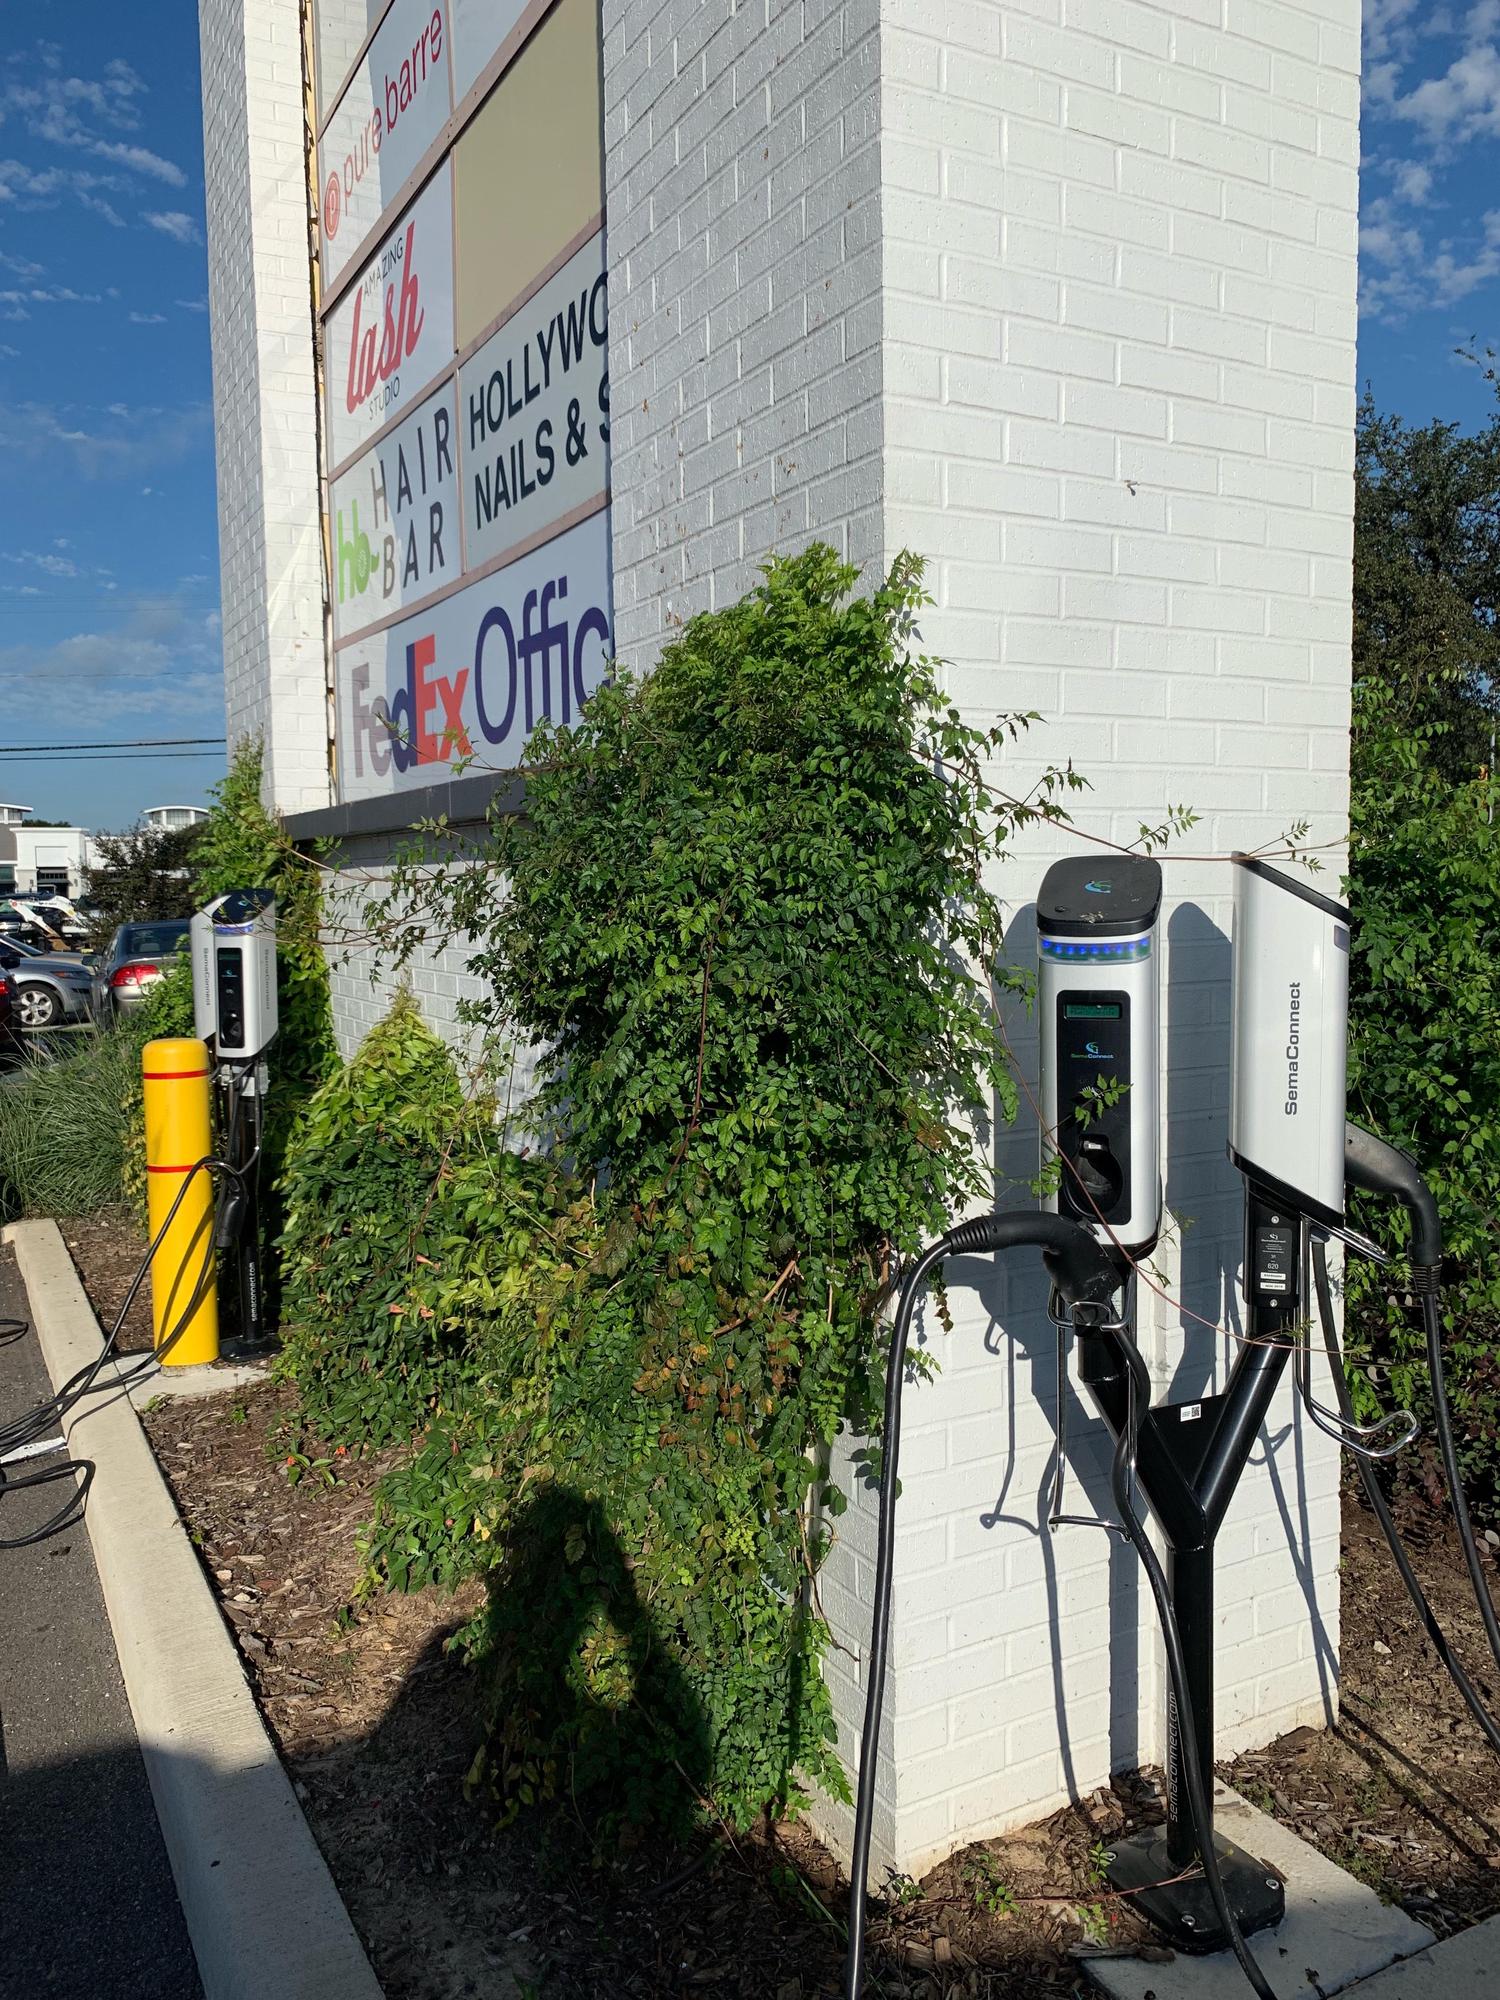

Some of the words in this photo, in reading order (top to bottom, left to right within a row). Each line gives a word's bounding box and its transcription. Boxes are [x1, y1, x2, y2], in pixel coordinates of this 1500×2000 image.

[343, 106, 382, 216] pure
[384, 8, 442, 135] barre
[346, 220, 425, 414] lash
[363, 236, 404, 298] AMAZING
[369, 376, 400, 420] STUDIO
[370, 406, 453, 530] HAIR
[474, 418, 555, 531] NAILS
[565, 398, 588, 467] &
[383, 501, 445, 600] BAR
[351, 633, 473, 778] FedEx
[1284, 981, 1301, 1116] SemaConnect
[1169, 1691, 1178, 1822] semaconnect.com
